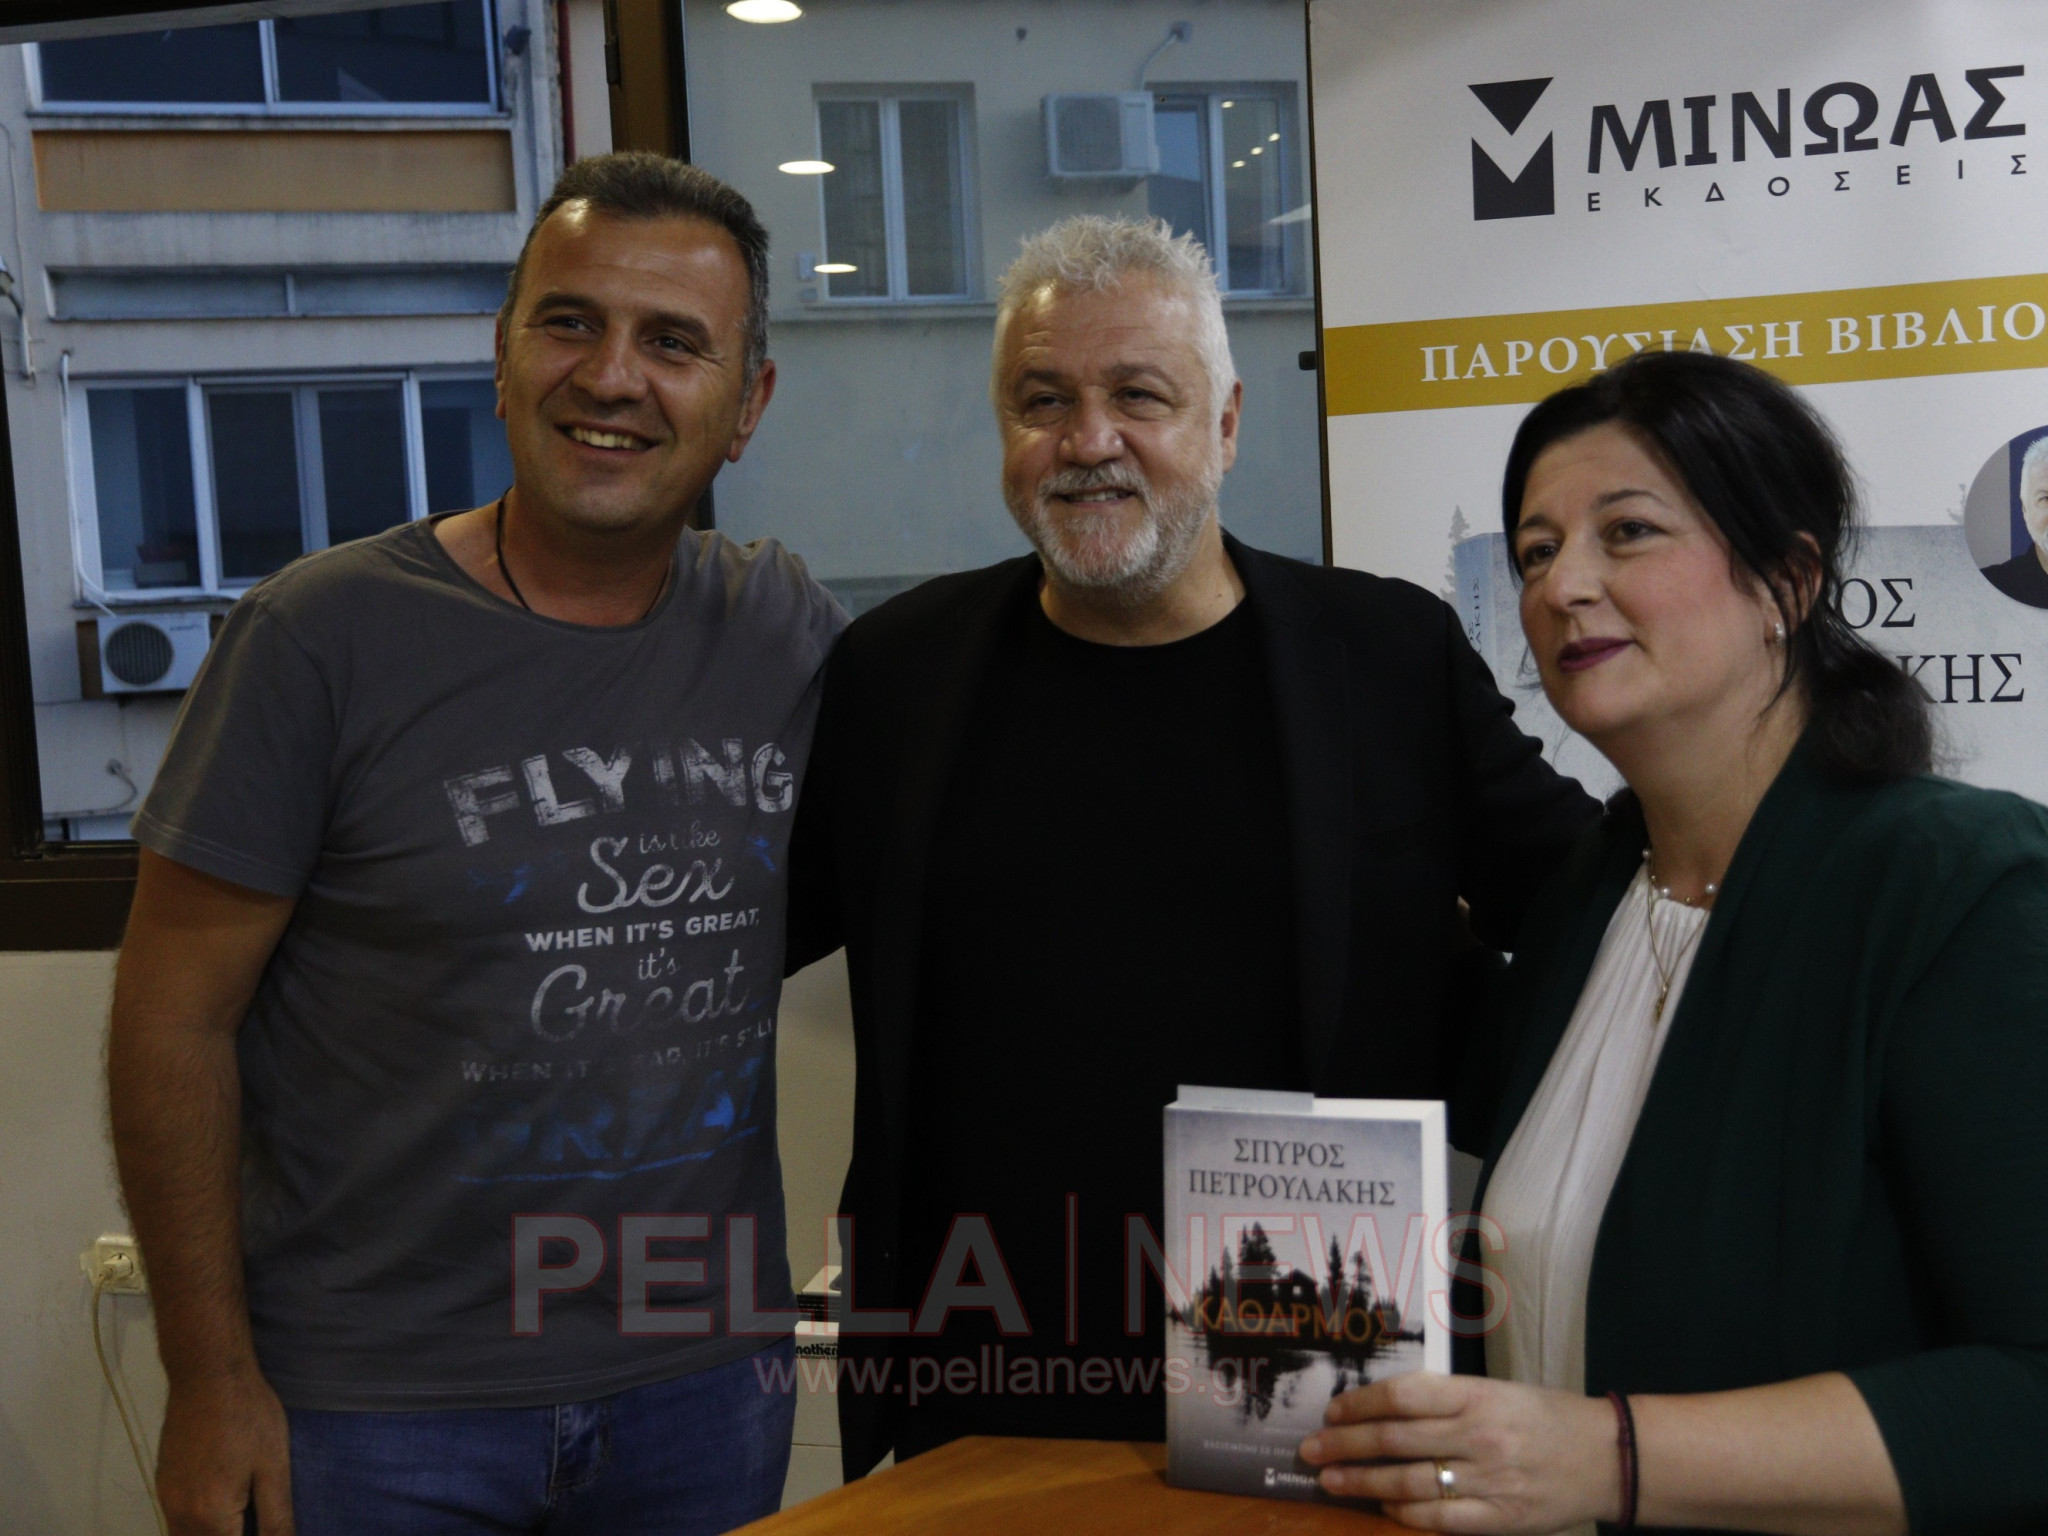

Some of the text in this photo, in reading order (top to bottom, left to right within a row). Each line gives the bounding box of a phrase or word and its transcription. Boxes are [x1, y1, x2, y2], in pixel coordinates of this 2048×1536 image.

[1587, 65, 2026, 174] ΜΙΝΩΑΣ
[1587, 154, 2027, 212] ΕΚΔΟΣΕΙΣ
[1826, 302, 2047, 355] ΒΙΒΛΙΟ
[444, 737, 793, 847] FLYING
[577, 836, 735, 913] Sex
[525, 926, 615, 952] WHEN
[626, 919, 674, 944] IT'S
[531, 949, 750, 1042] Great
[1233, 1138, 1346, 1168] ΣΠΥΡΟΣ
[1188, 1169, 1396, 1206] ΠΕΤΡΟΥΛΑΚΗΣ
[1193, 1295, 1397, 1345] ΚΑΘΑΡΜΟΣ
